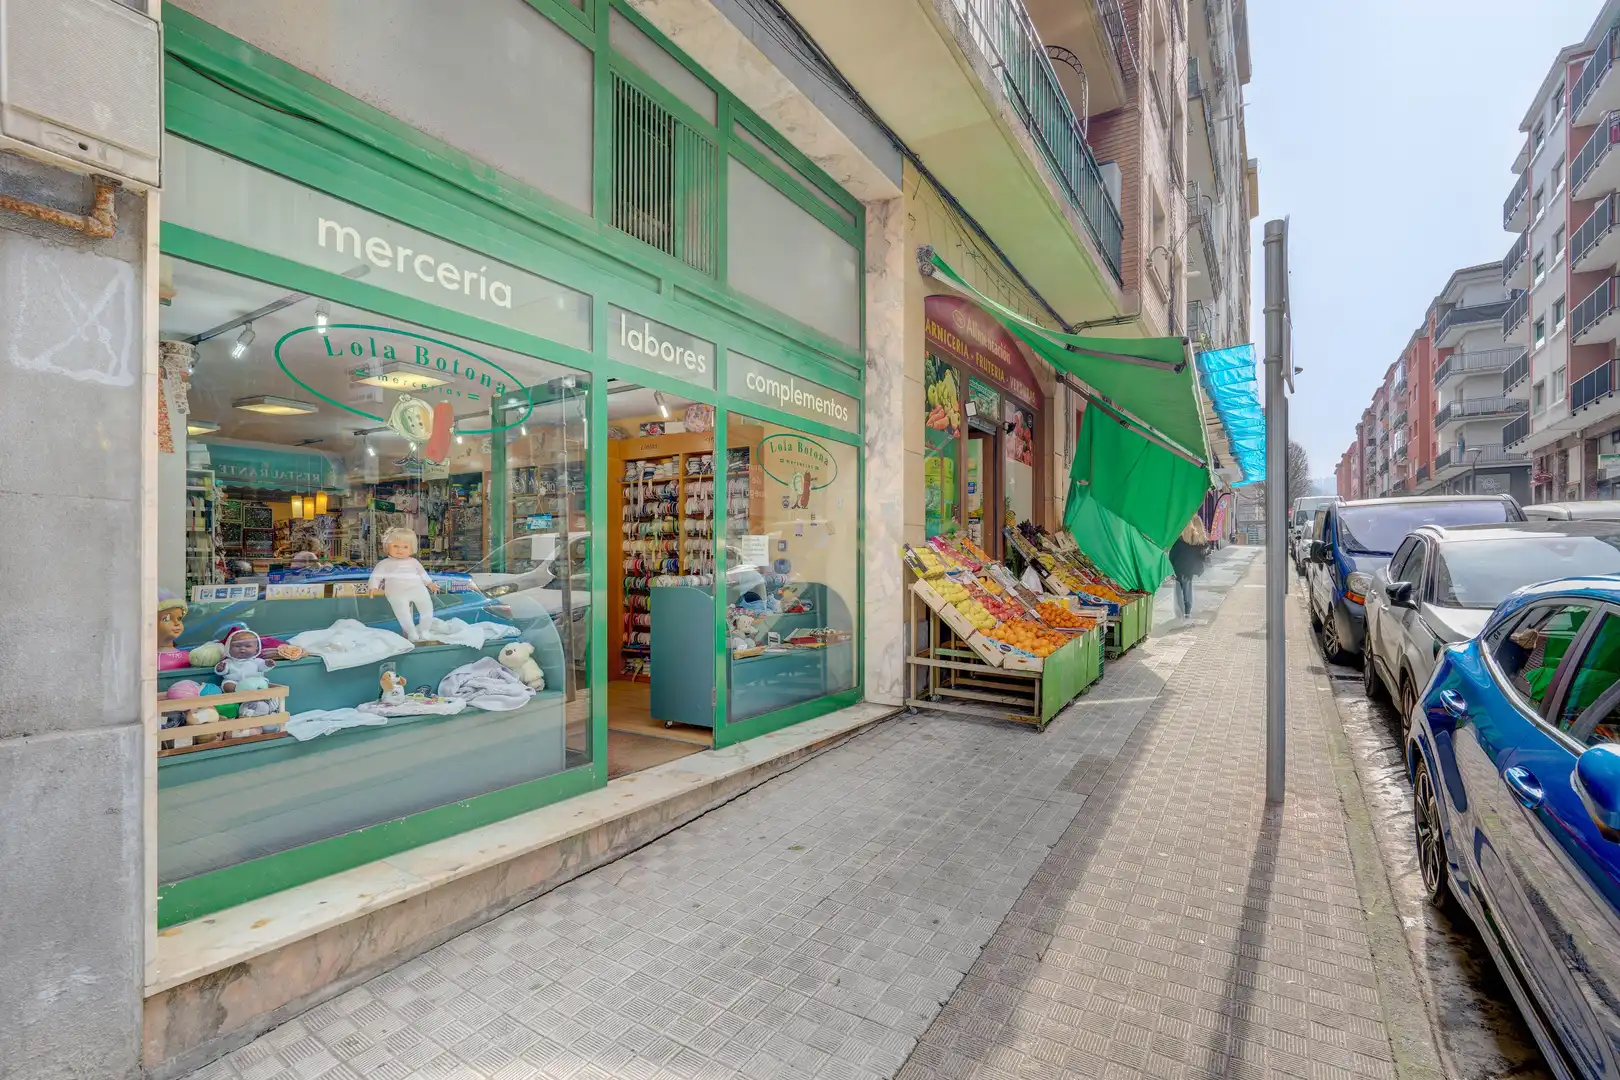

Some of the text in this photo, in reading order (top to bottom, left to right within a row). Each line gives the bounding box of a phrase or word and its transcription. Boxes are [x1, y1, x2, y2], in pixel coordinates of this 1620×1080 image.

[317, 216, 512, 309] mercería
[323, 335, 507, 397] Lola Botona
[620, 313, 706, 374] labores
[925, 318, 969, 360] ARNICERIA
[975, 352, 1005, 383] FRUTERIA
[746, 371, 848, 422] complementos
[769, 440, 829, 466] Lola Botona
